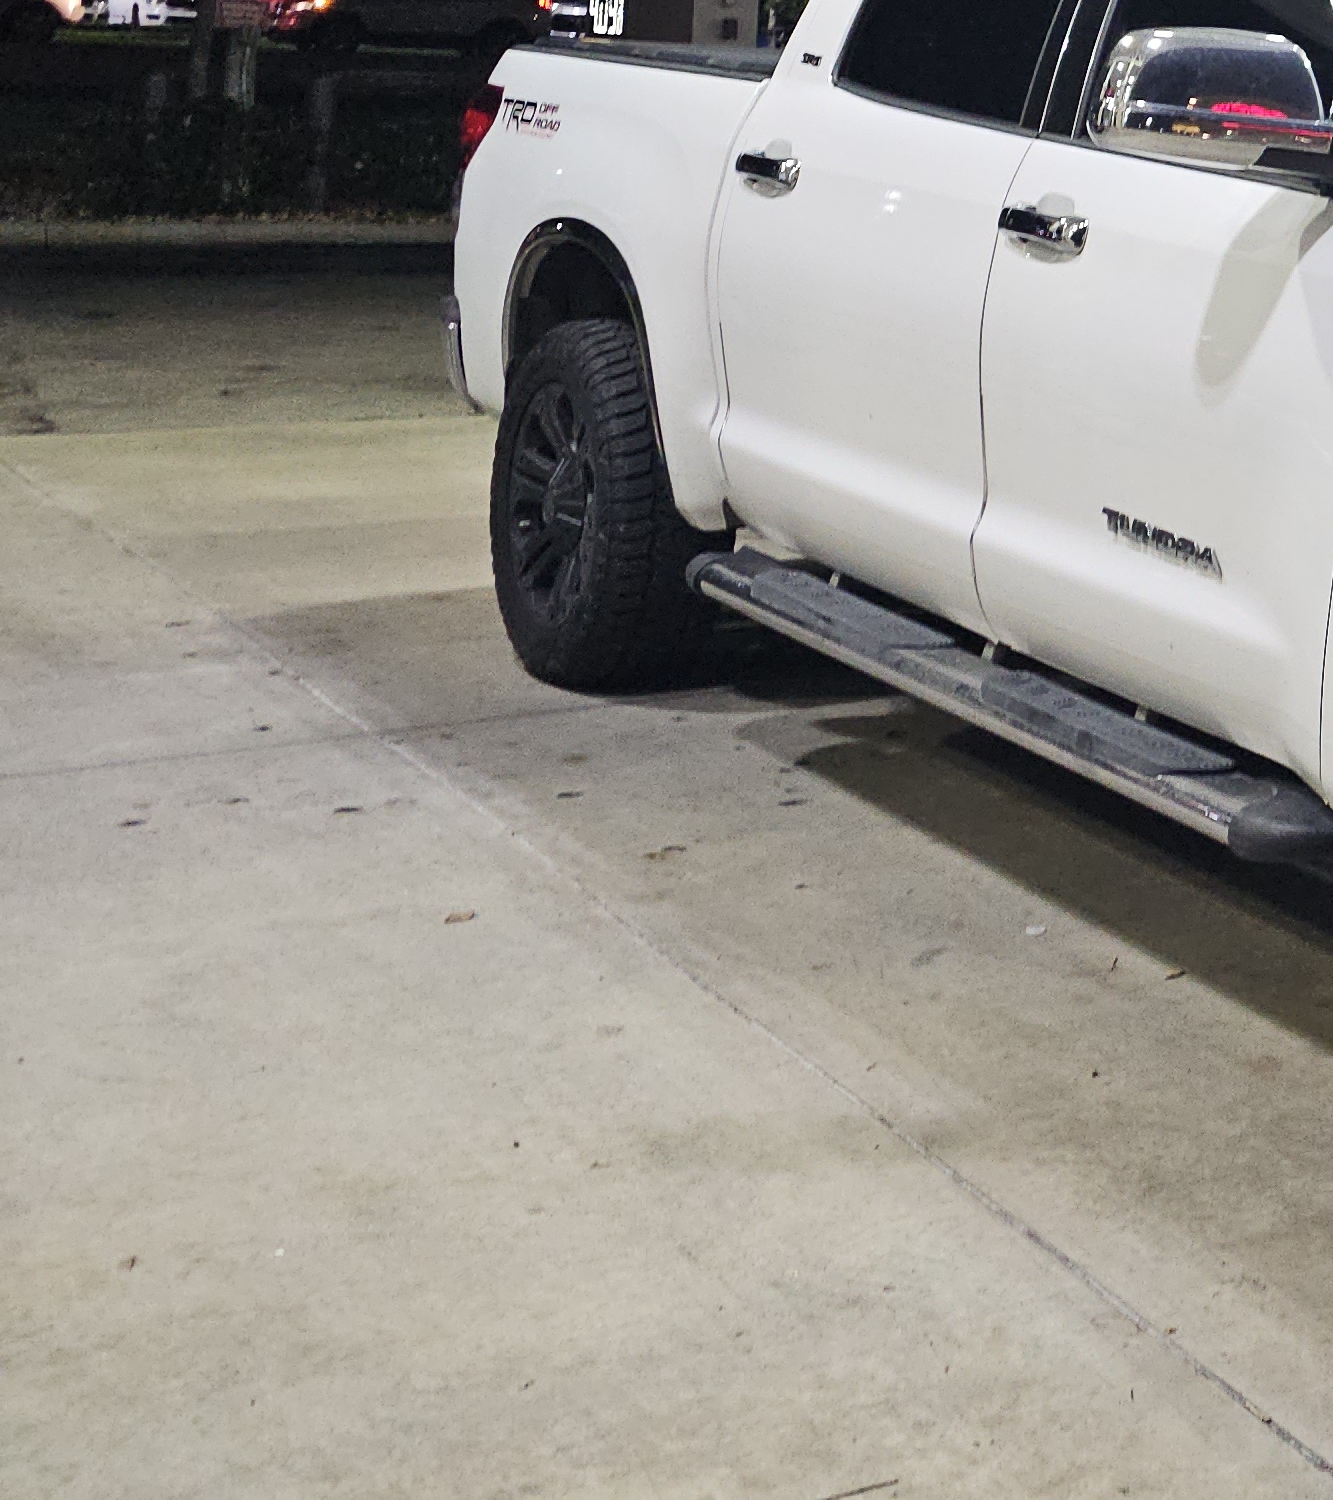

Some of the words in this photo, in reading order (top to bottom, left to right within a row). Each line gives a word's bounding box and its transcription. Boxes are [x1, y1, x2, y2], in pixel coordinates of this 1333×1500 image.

[502, 98, 538, 133] TRD
[538, 102, 560, 115] OFF
[532, 117, 561, 132] ROAD
